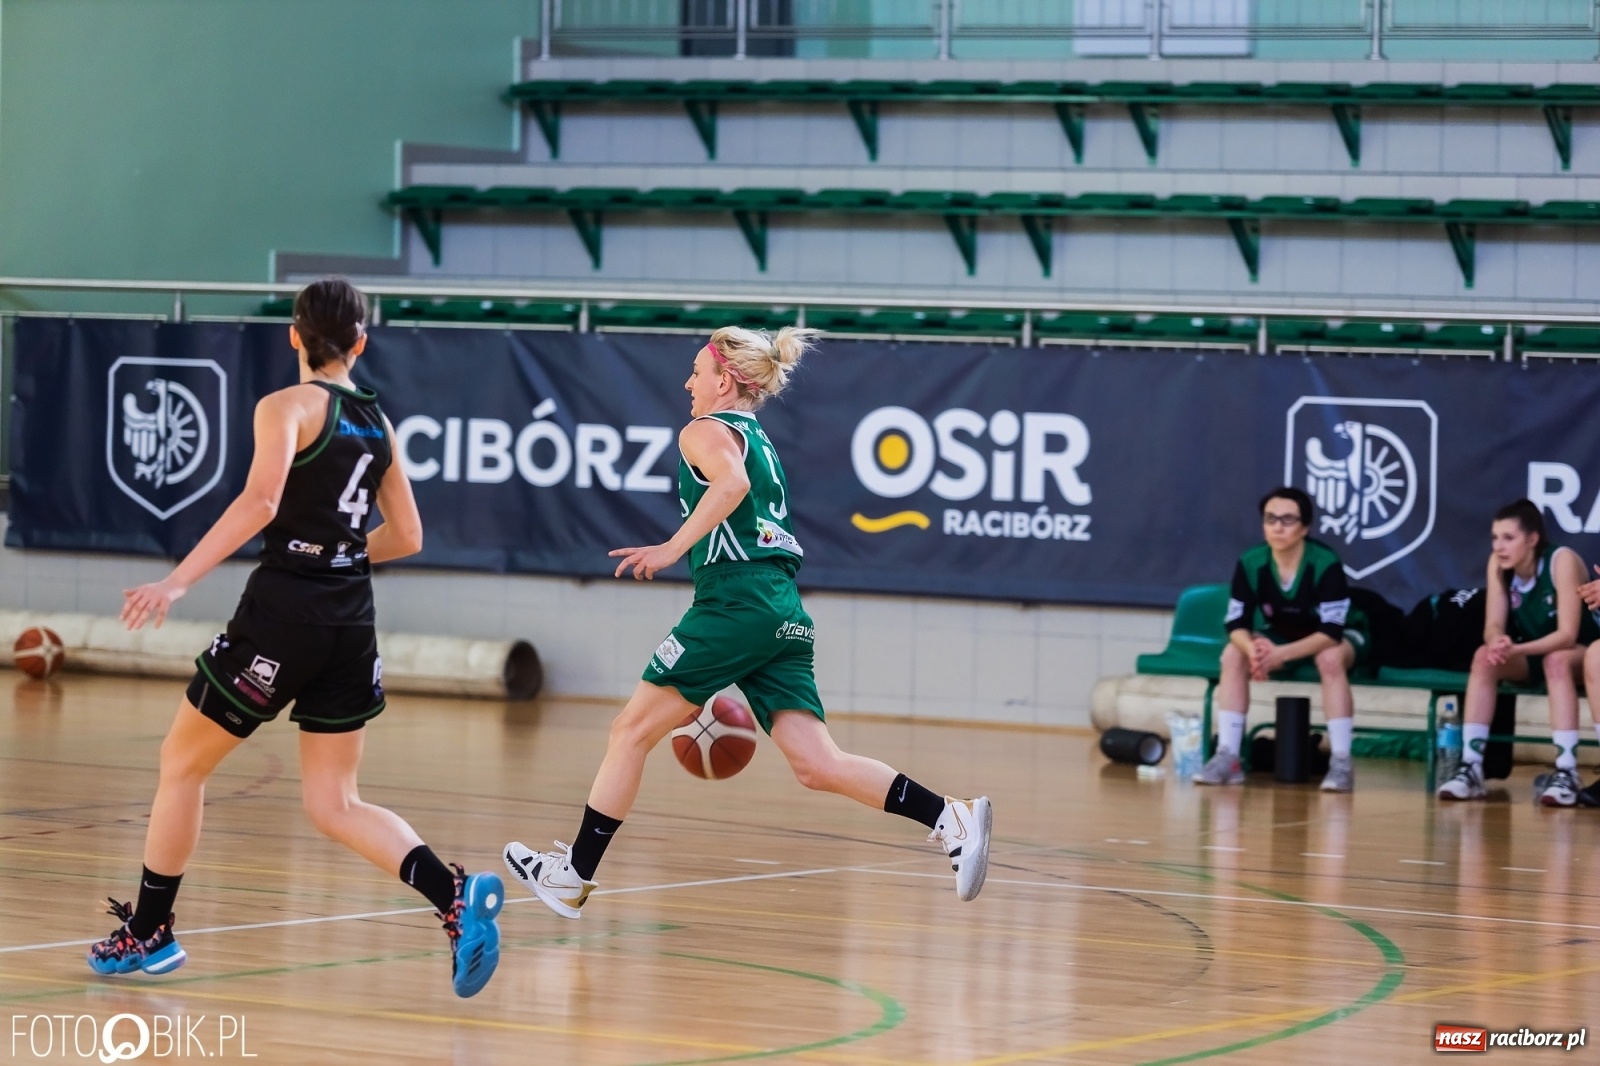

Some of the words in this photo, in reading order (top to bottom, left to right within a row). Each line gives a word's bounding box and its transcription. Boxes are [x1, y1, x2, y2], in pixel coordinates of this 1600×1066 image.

[395, 397, 673, 493] CIBÓRZ
[851, 405, 1093, 506] OSiR
[337, 453, 374, 529] 4
[943, 505, 1092, 542] RACIBÓRZ
